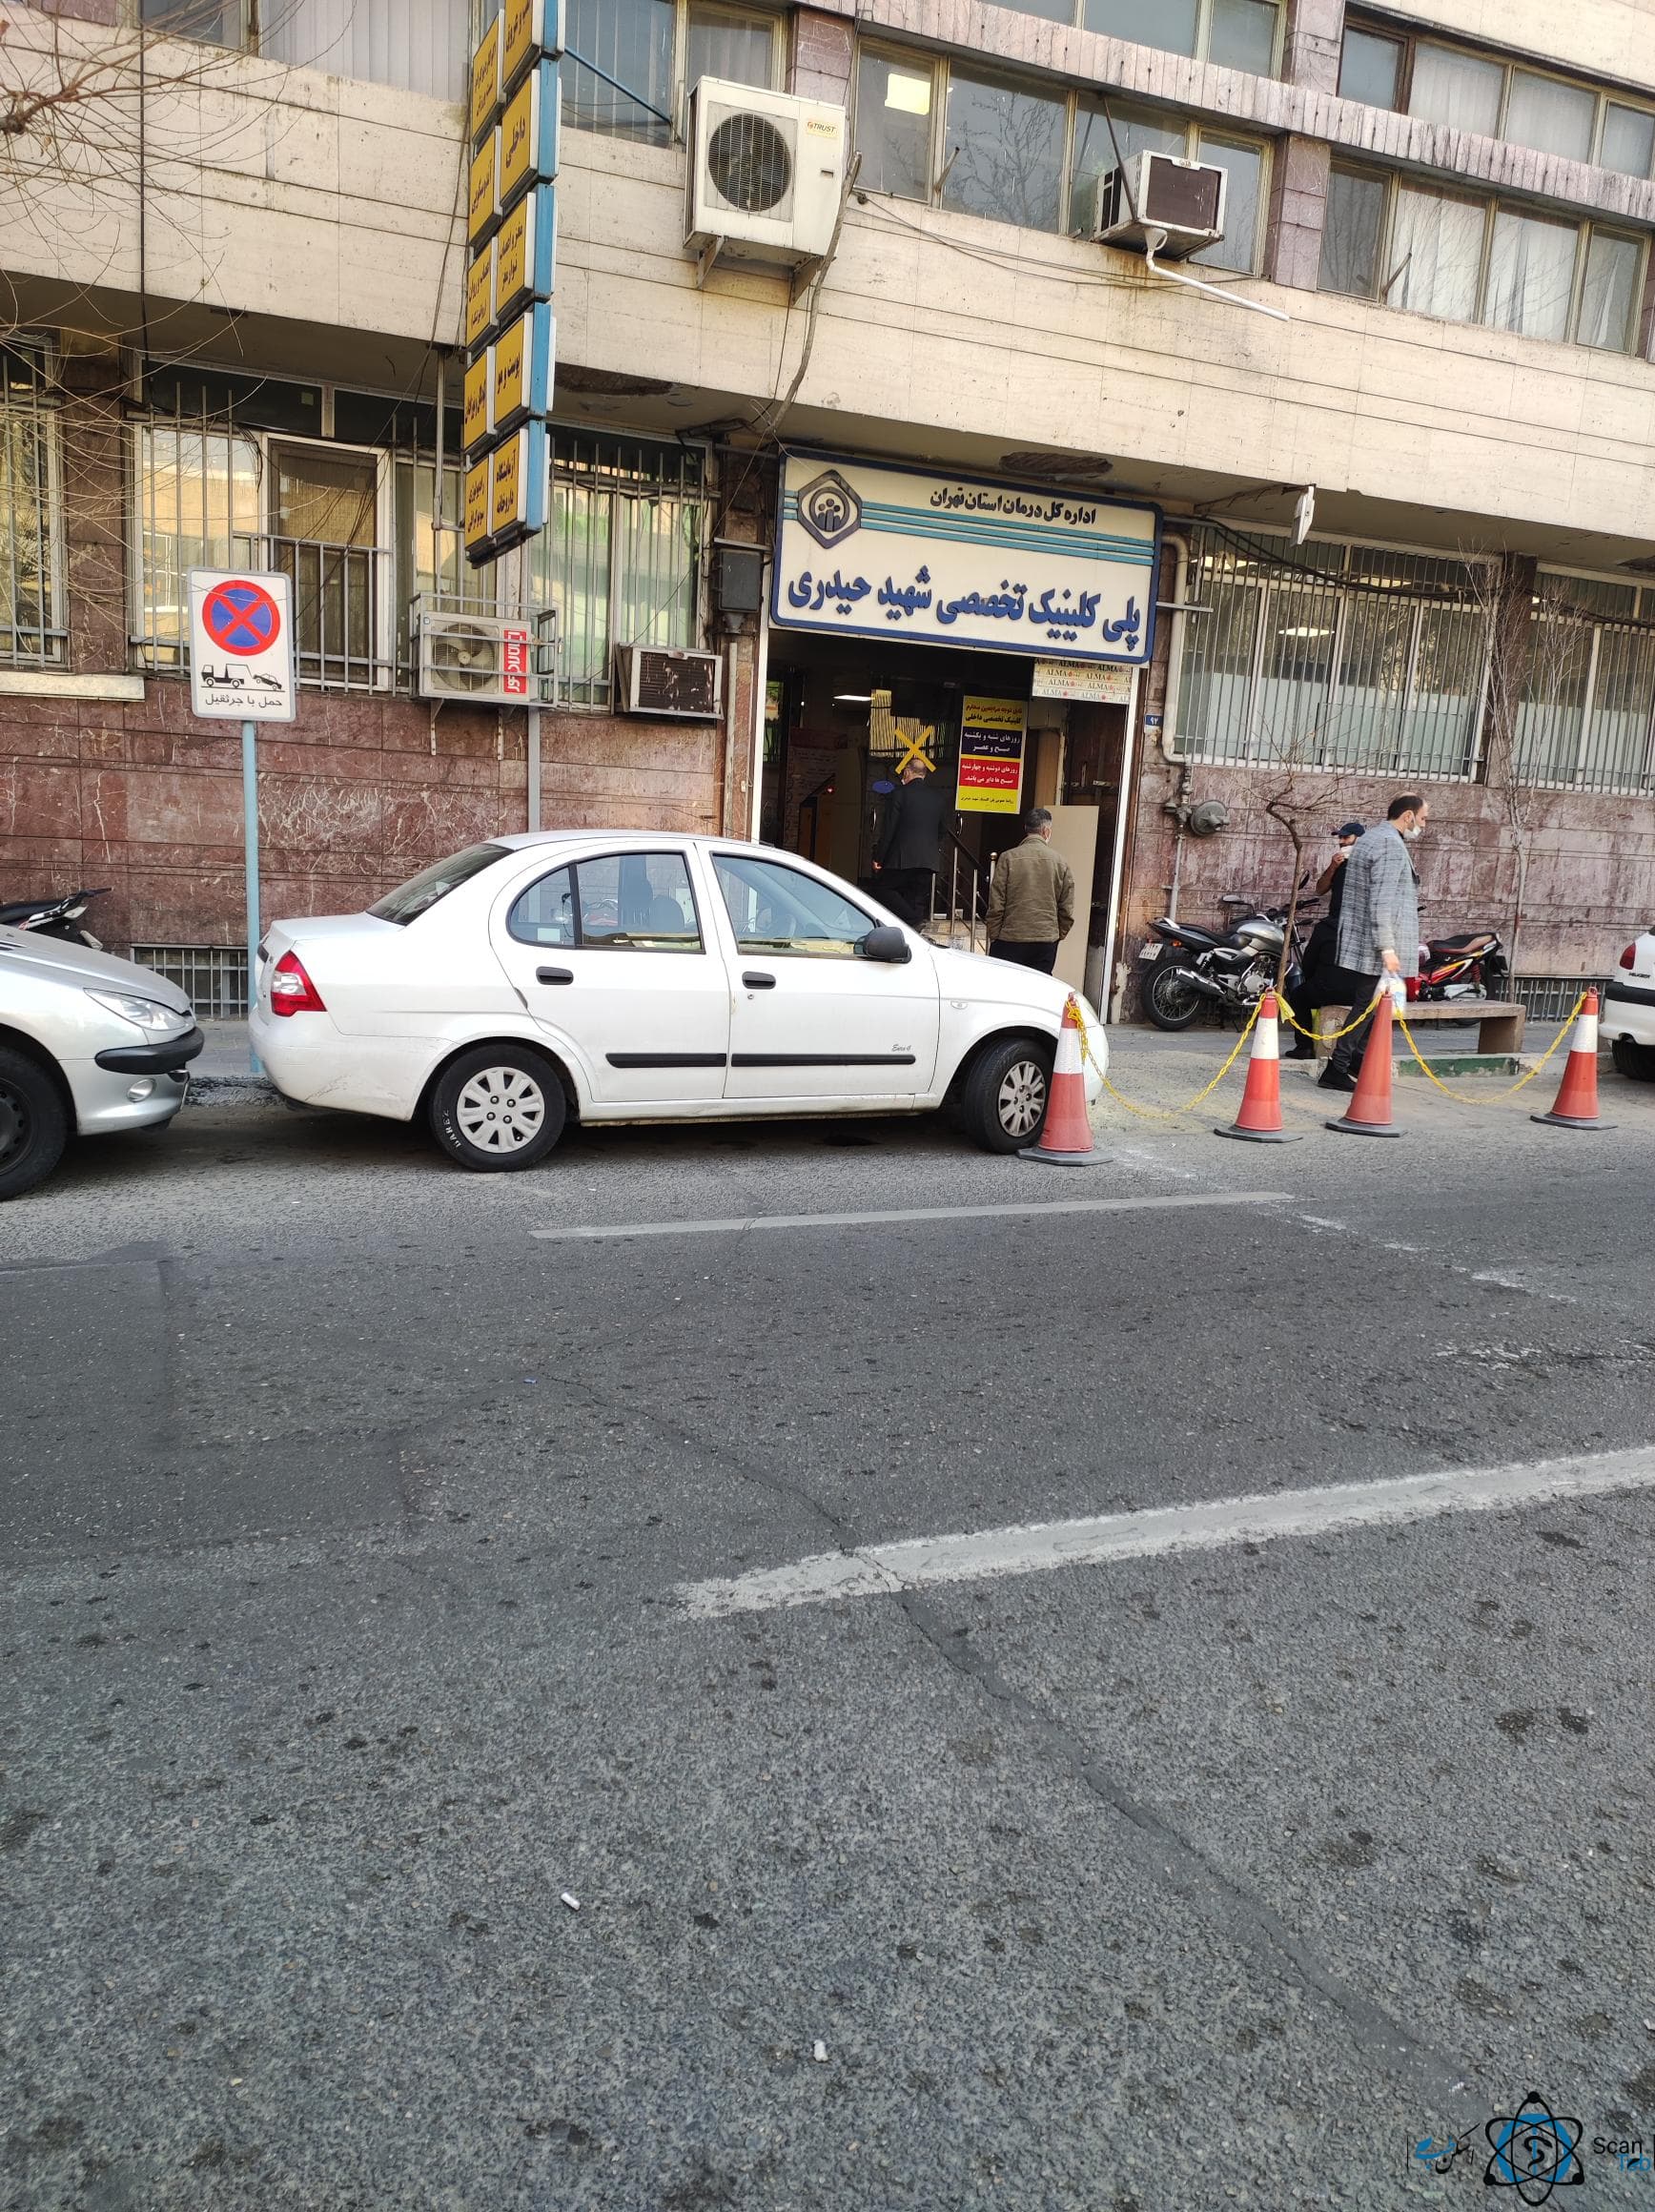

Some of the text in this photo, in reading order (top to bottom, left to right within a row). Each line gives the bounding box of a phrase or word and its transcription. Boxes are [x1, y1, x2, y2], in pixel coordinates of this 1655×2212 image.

[813, 122, 837, 133] TRUST
[505, 114, 525, 169] داخلی
[930, 486, 1096, 524] اداره کل درمان استان تهران
[787, 564, 1141, 652] پلی کلینیک تخصصی شهید حیدری
[205, 693, 282, 708] حمل با جرثقیل
[966, 713, 982, 722] داخلی
[1005, 716, 1022, 725] کلینیک
[964, 731, 982, 740] یکشنبه
[999, 734, 1020, 744] روزهای
[1001, 766, 1018, 774] روزهای
